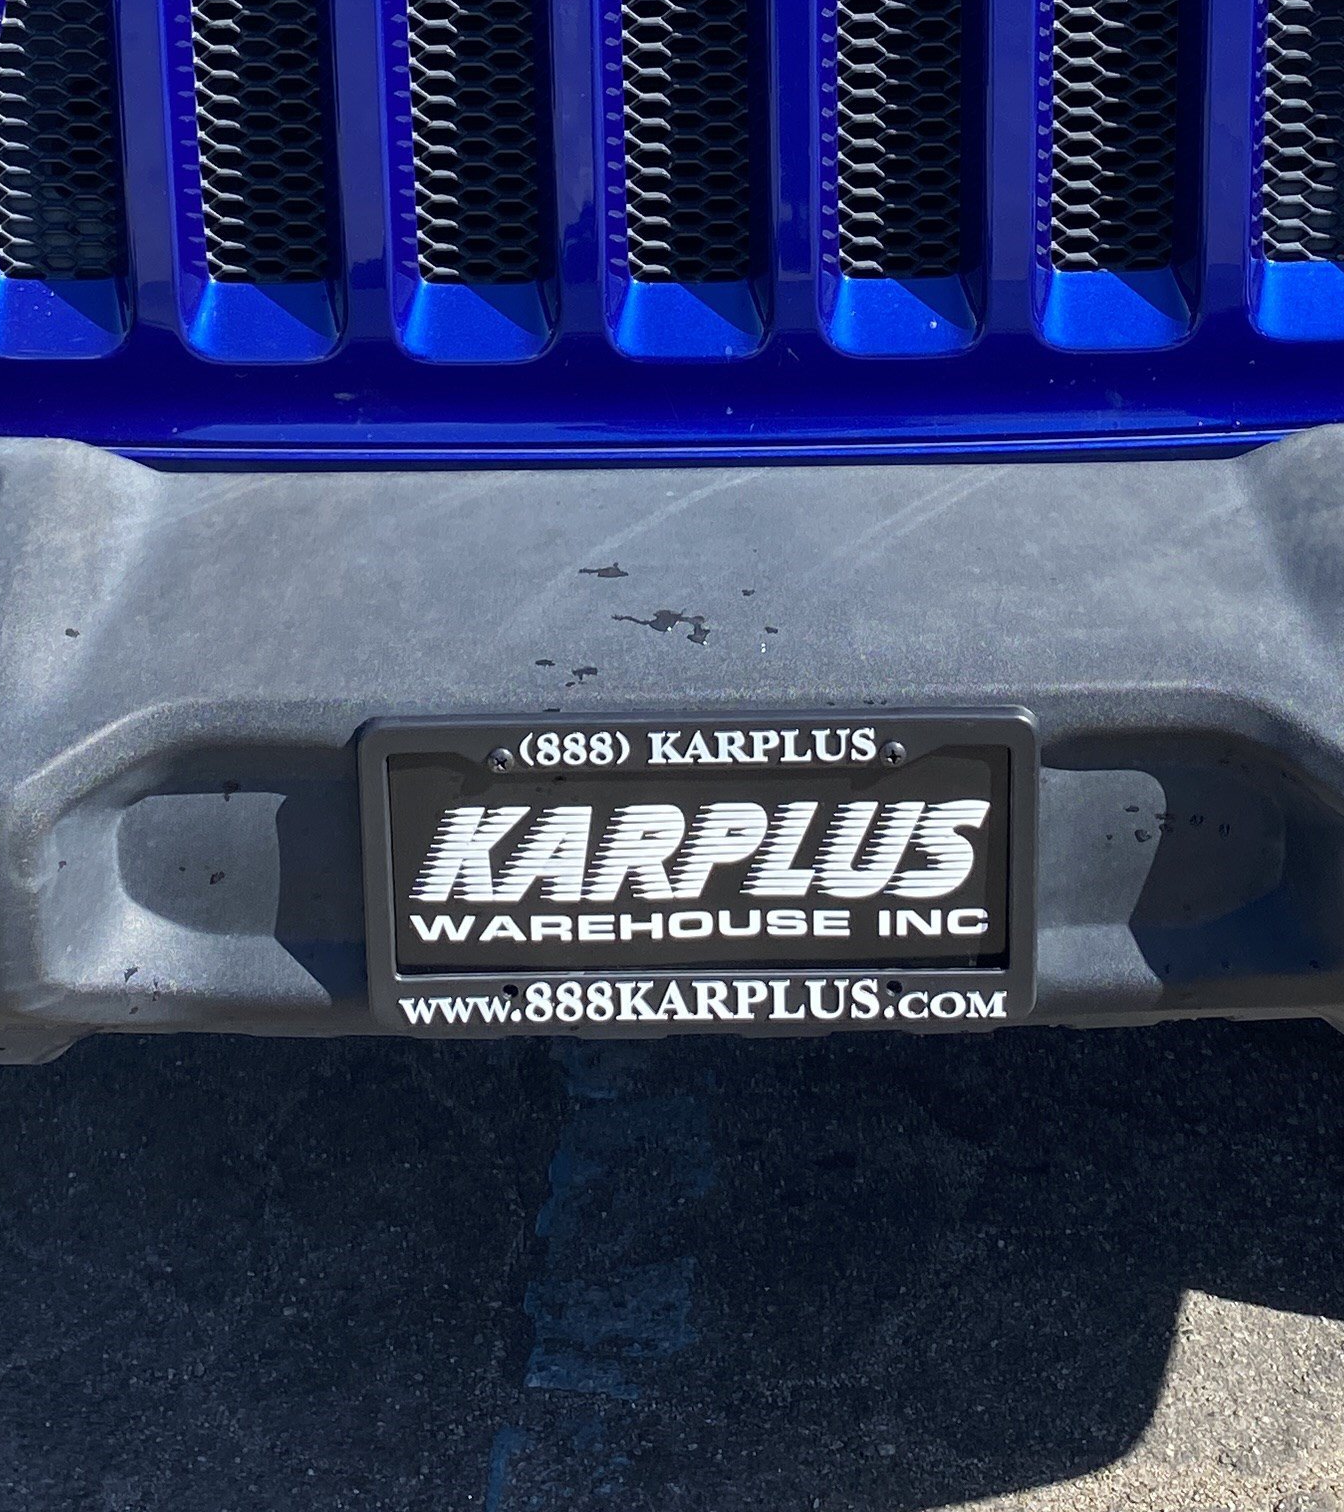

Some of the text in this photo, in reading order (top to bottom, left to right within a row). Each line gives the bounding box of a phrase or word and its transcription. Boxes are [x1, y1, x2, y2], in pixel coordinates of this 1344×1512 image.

[519, 727, 877, 766] (888) KARPLUS
[408, 799, 991, 902] KARPLUS
[409, 908, 989, 942] WAREHOUSE INC
